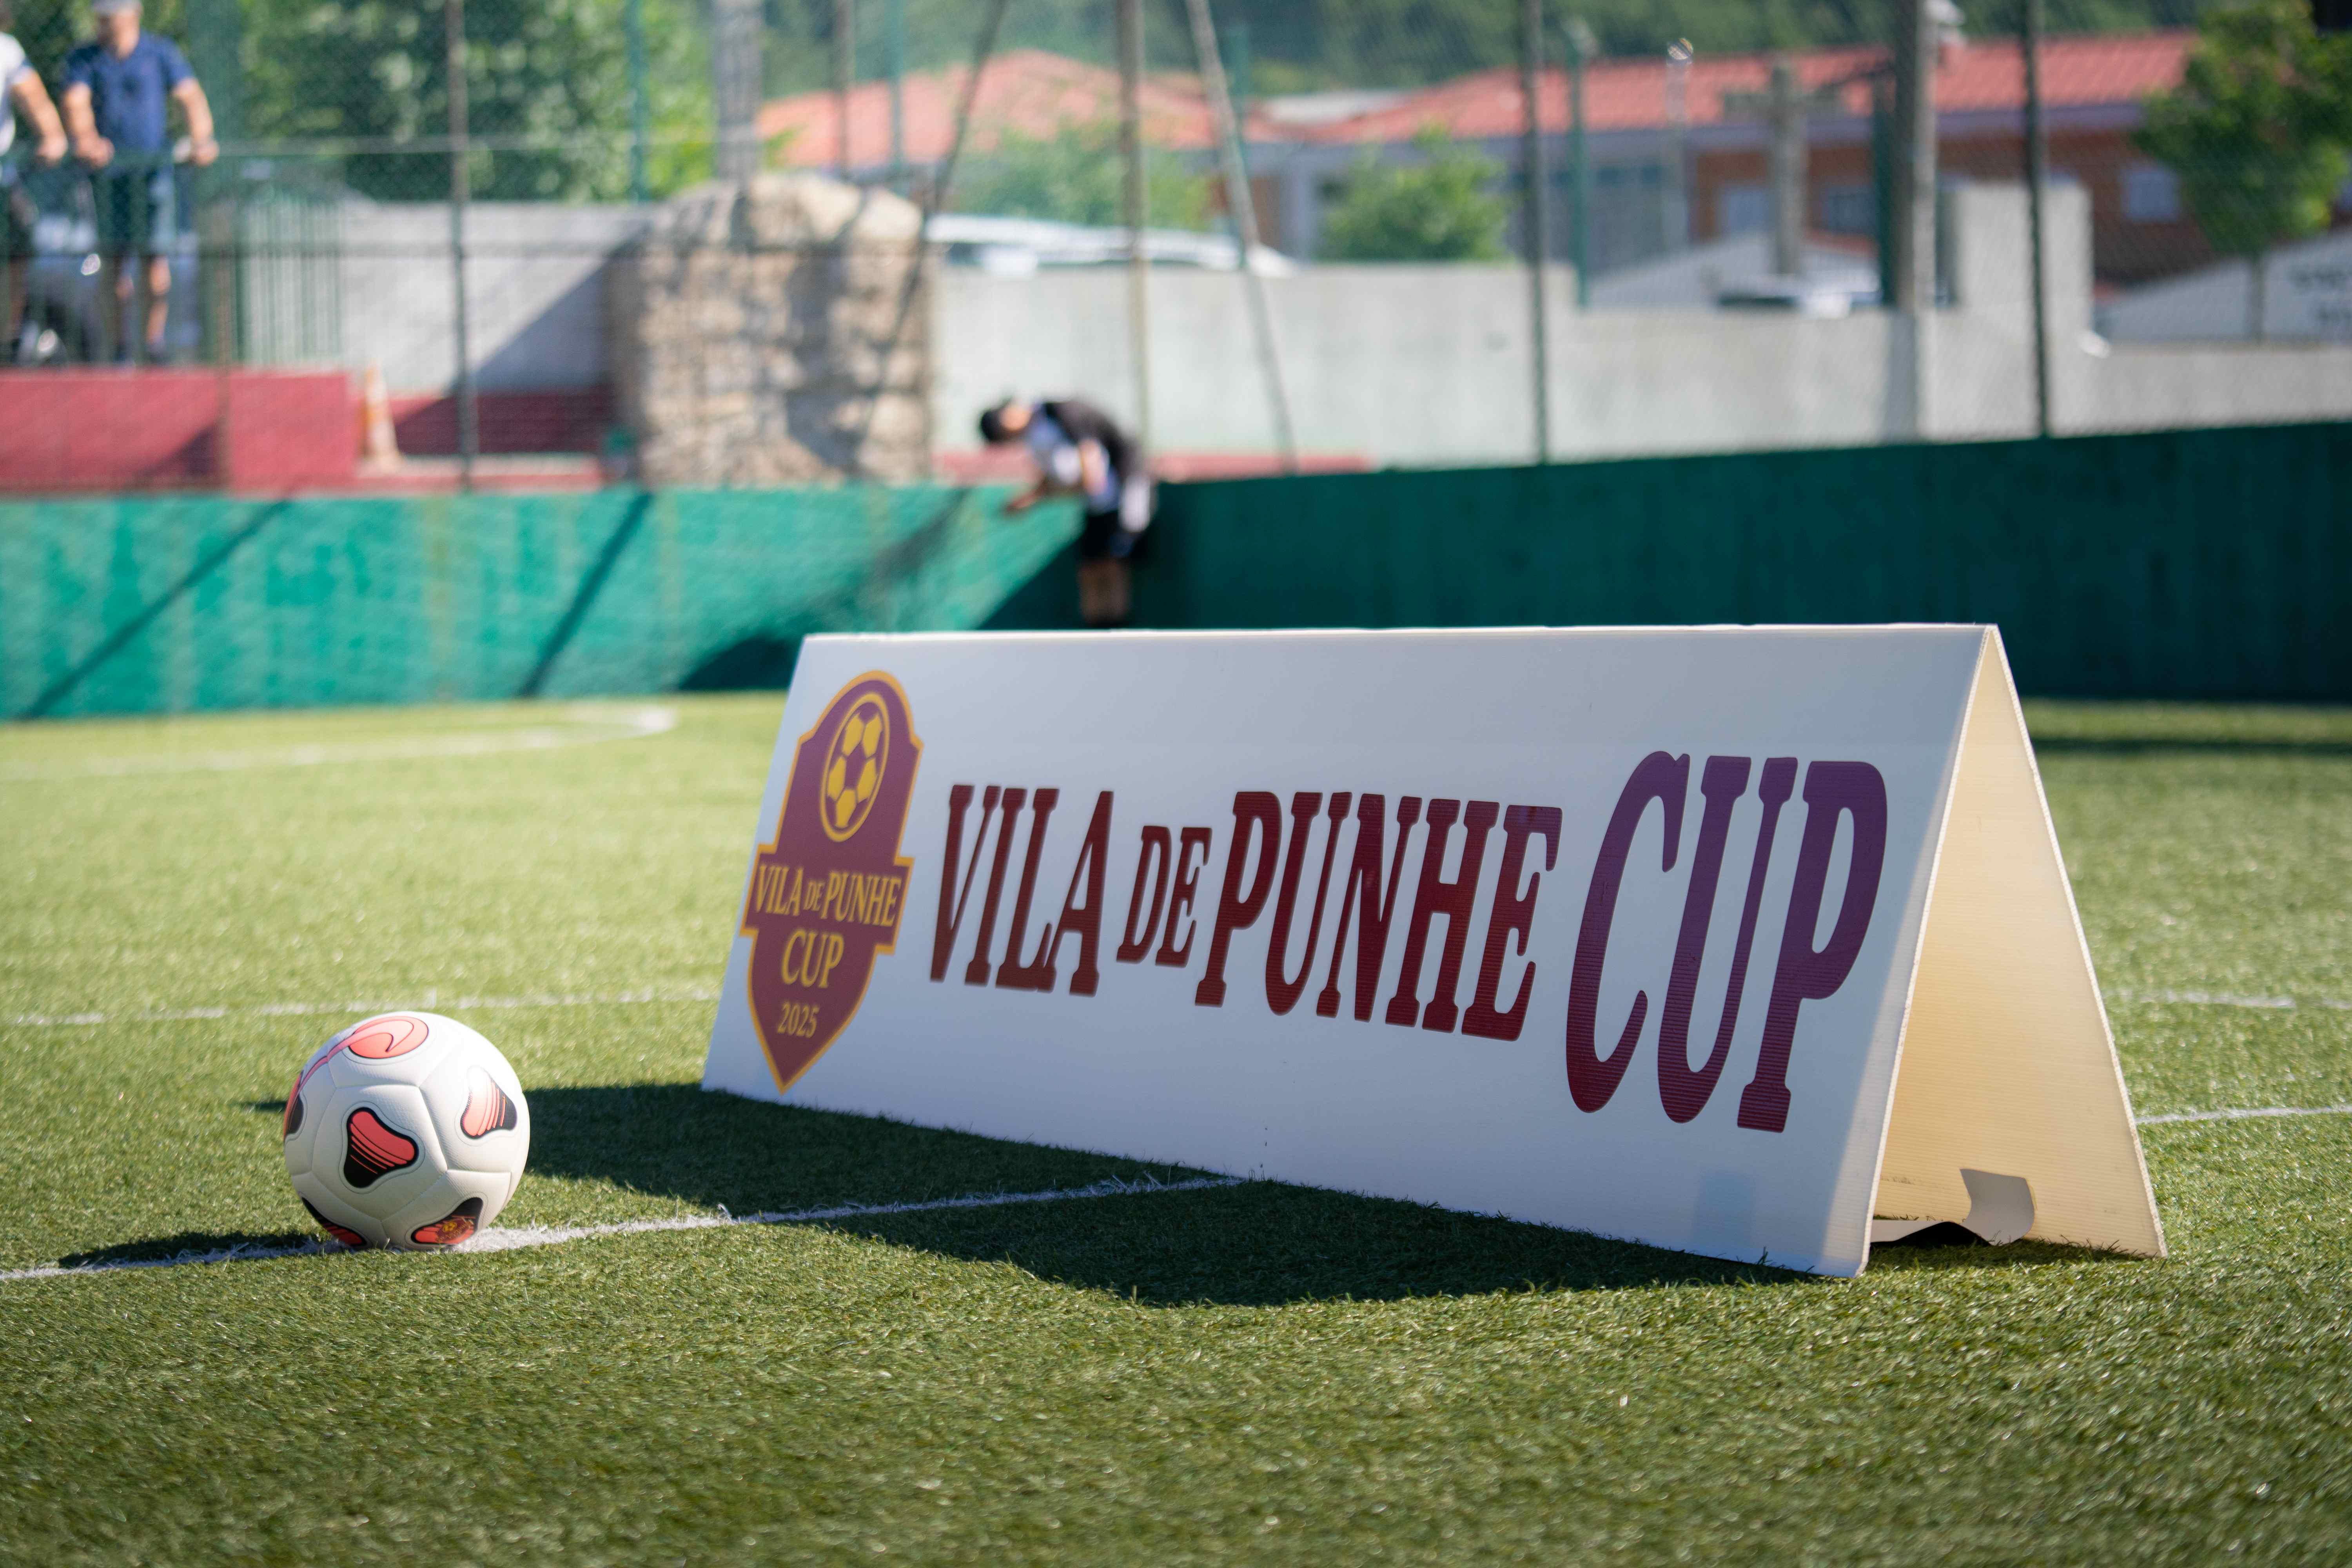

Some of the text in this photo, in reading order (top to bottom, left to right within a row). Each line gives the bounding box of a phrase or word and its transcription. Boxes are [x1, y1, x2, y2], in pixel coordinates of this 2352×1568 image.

[757, 864, 902, 926] VILA DE PUNHE
[781, 929, 844, 988] CUP
[931, 751, 1887, 1133] VILA DE PUNHE CUP
[777, 1002, 819, 1038] 2025
